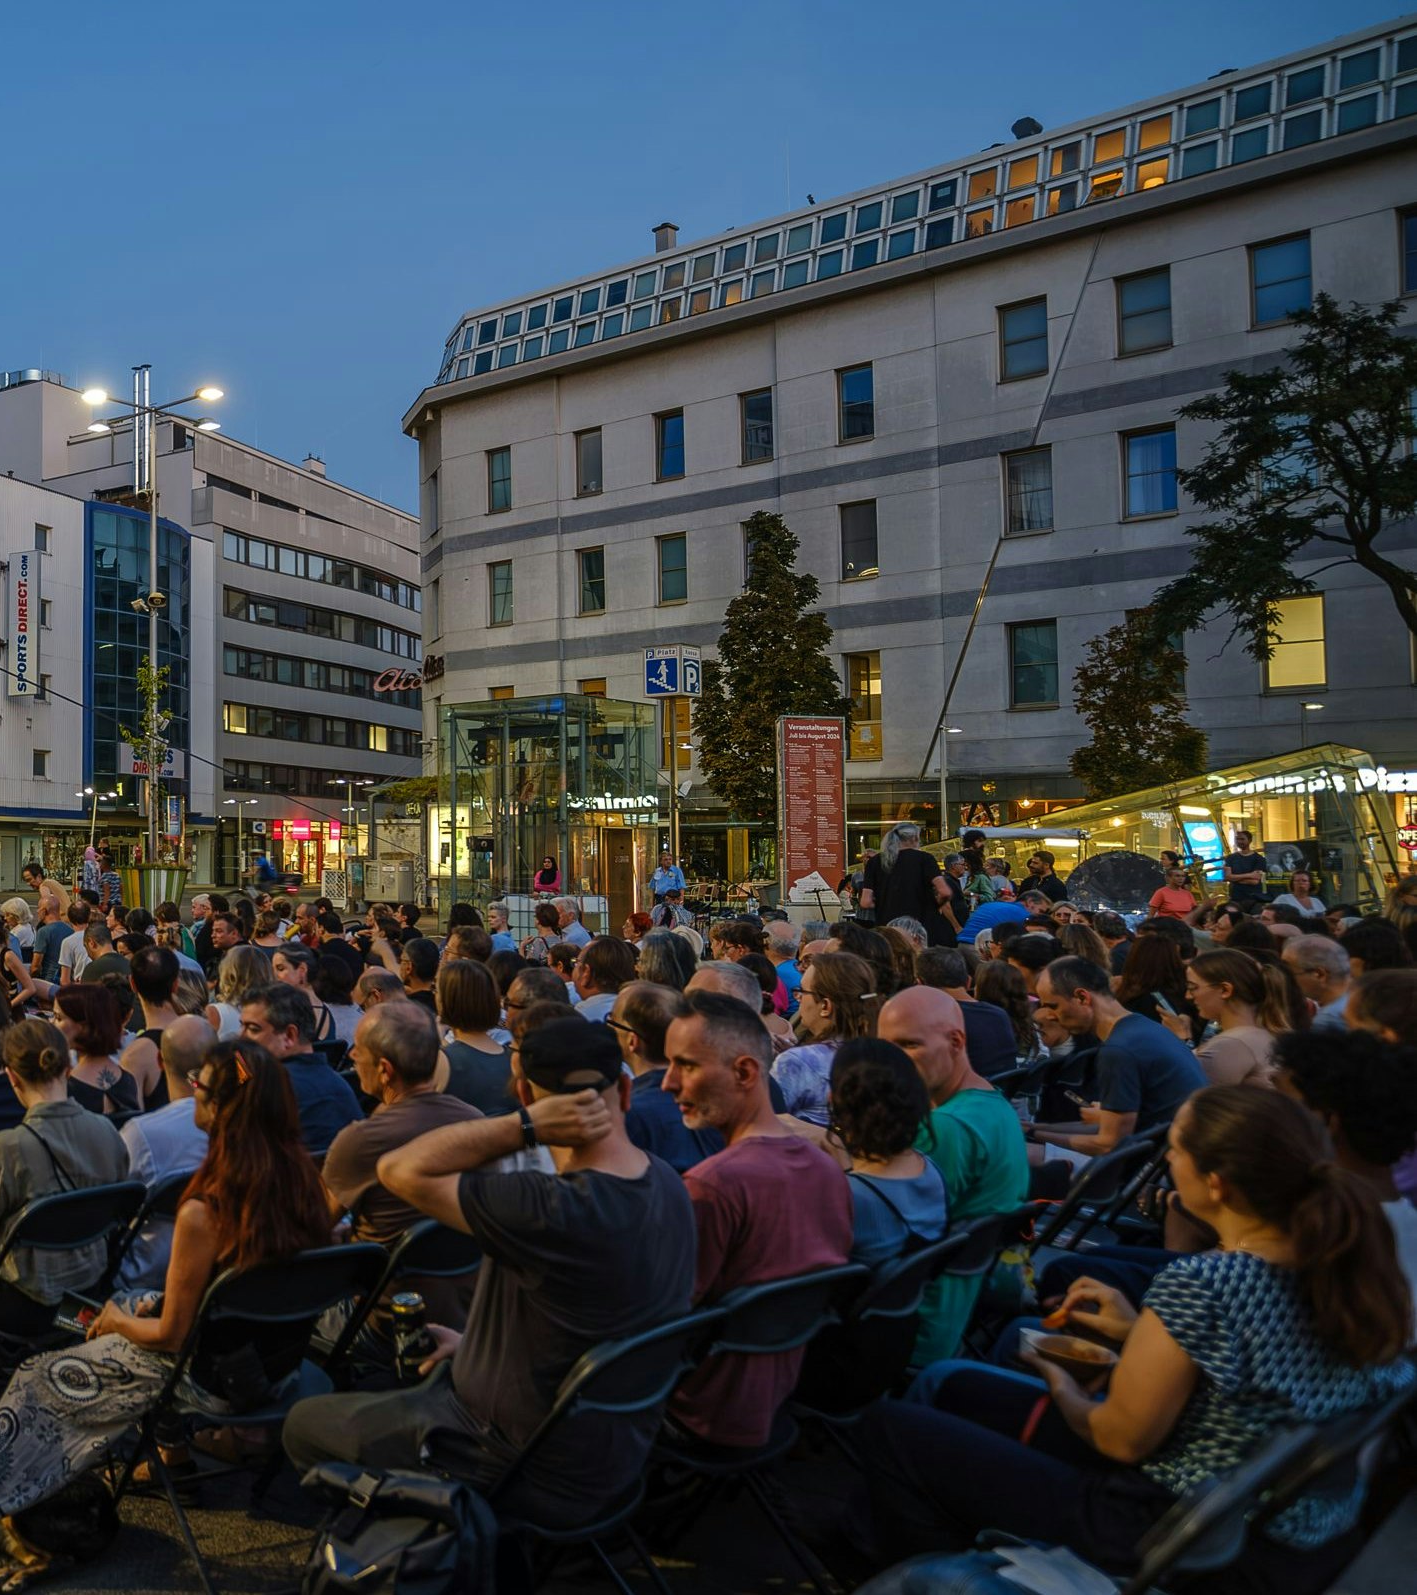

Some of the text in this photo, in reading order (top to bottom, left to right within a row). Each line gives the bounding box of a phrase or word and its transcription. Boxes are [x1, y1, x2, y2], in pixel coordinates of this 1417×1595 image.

[657, 648, 676, 656] Platz
[788, 723, 839, 733] Veranstaltungen
[1206, 769, 1346, 795] Domino's
[1397, 829, 1417, 841] OPE
